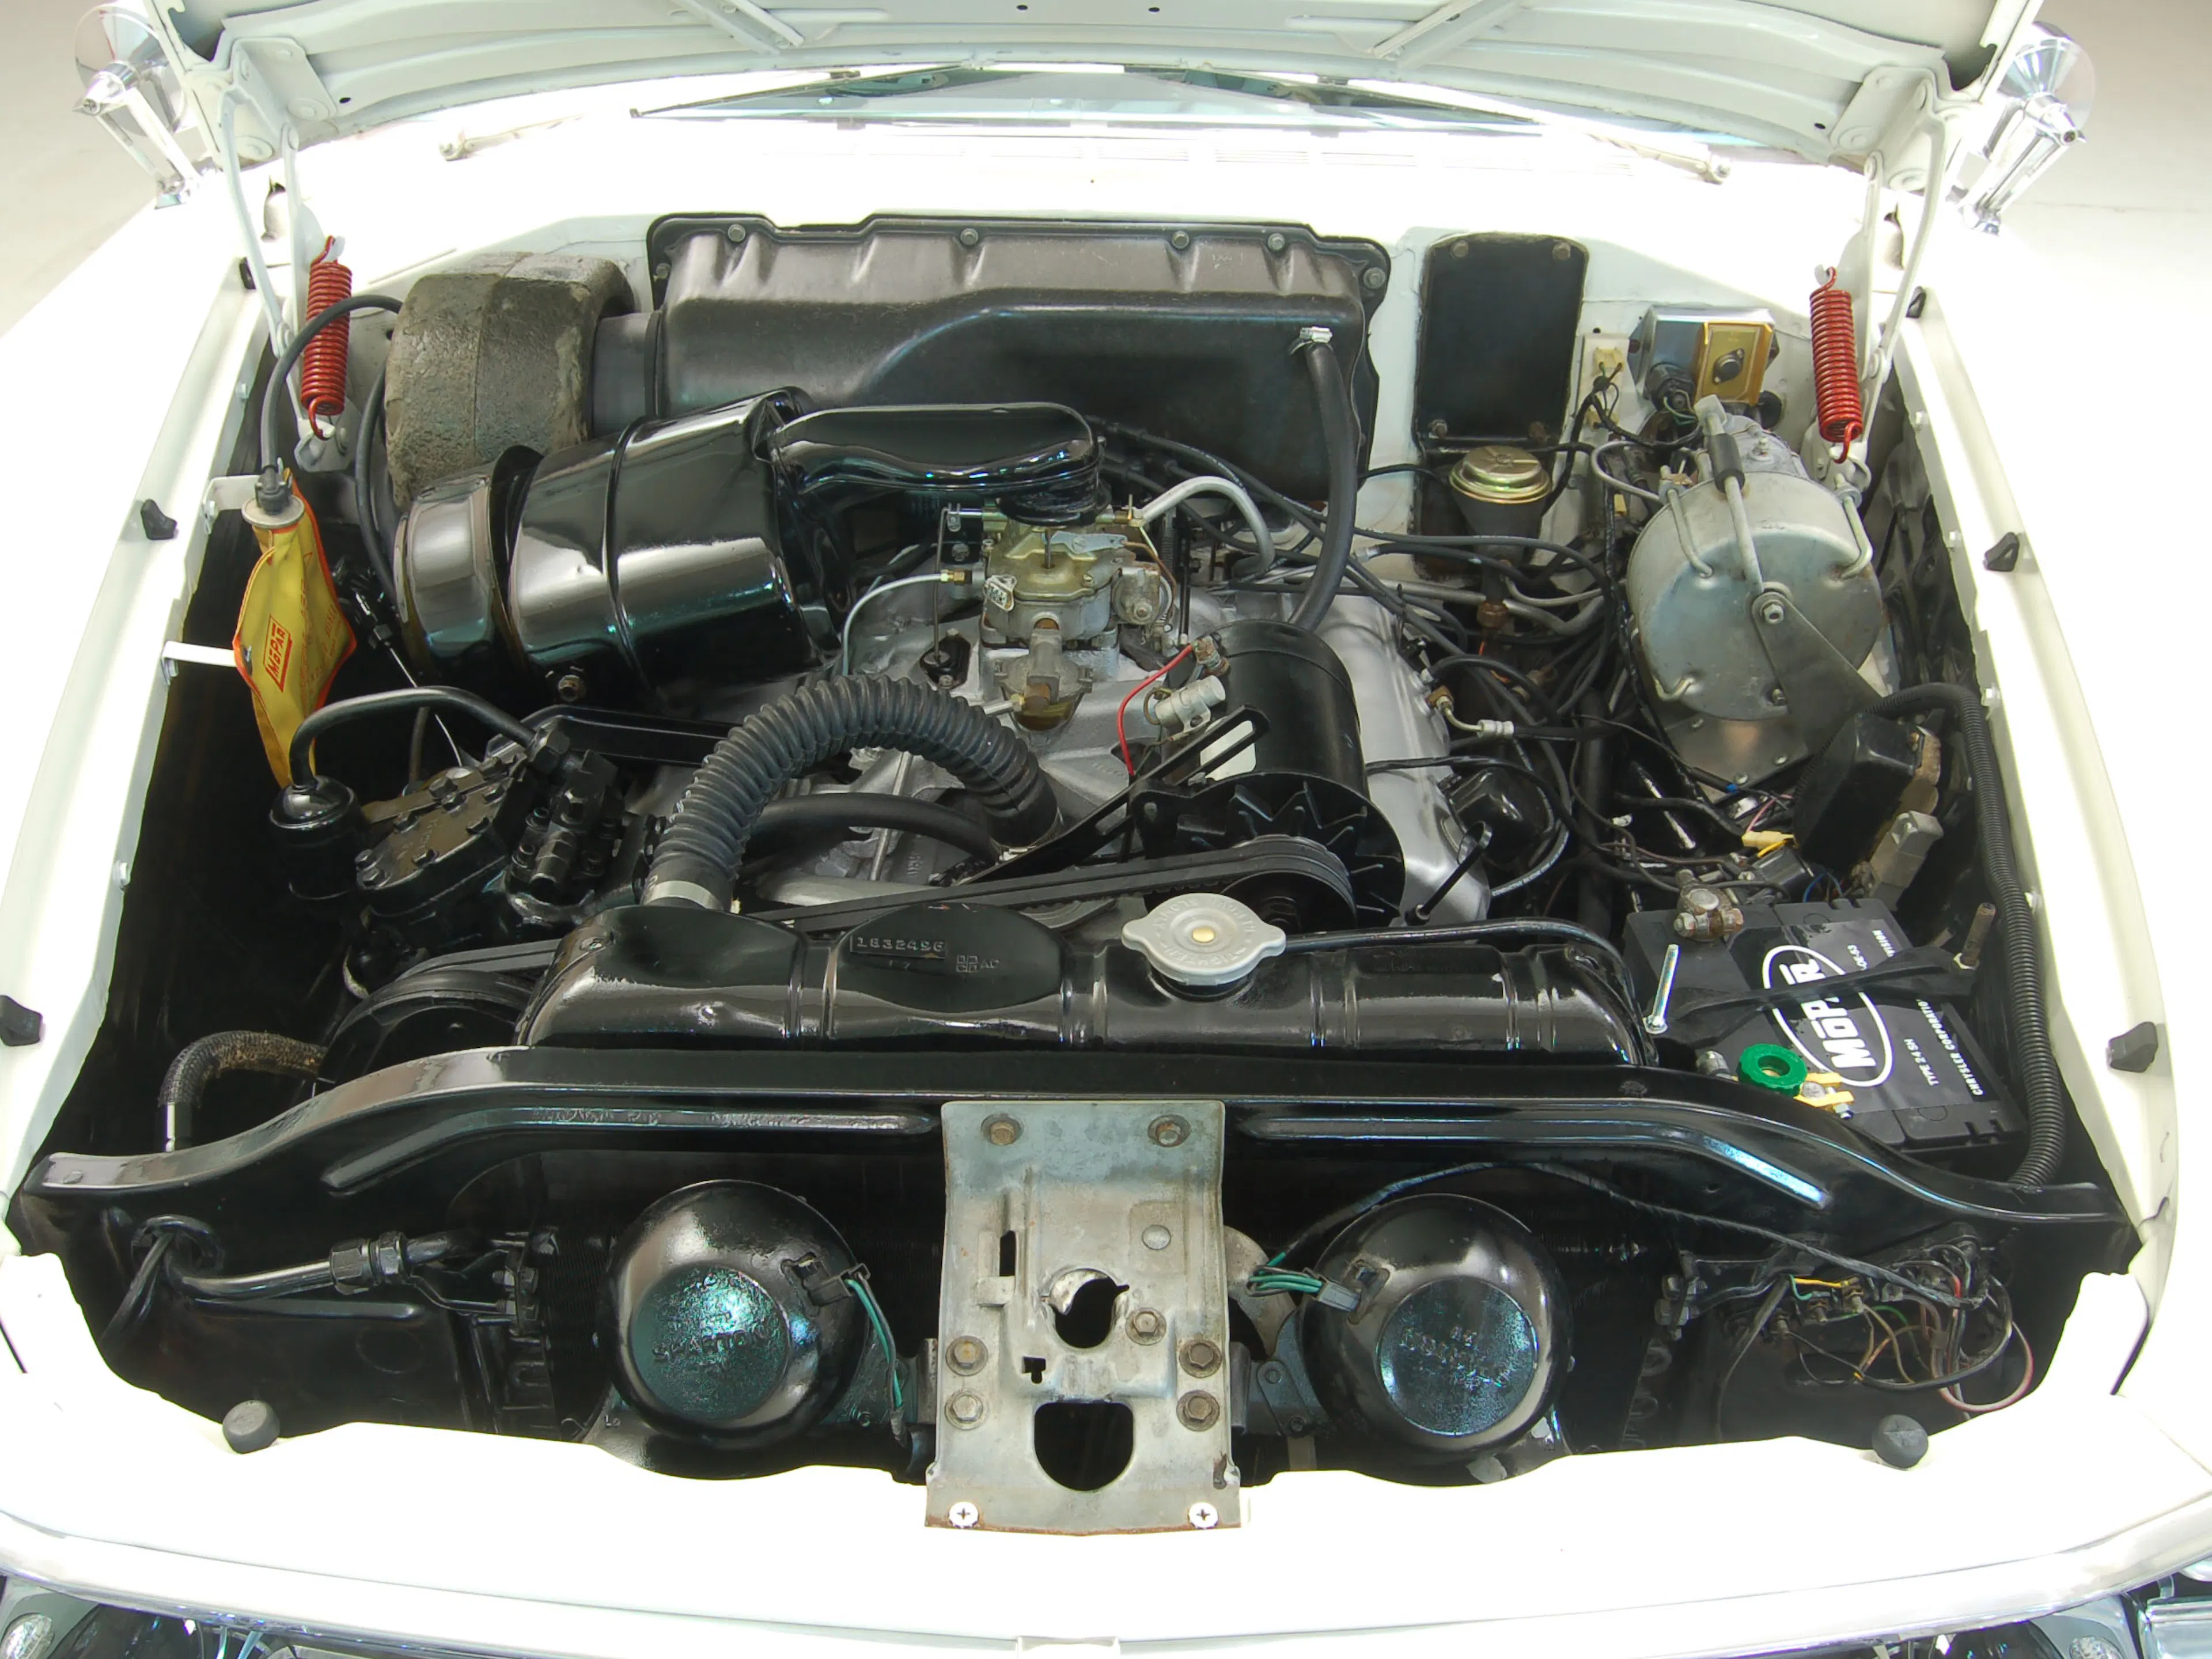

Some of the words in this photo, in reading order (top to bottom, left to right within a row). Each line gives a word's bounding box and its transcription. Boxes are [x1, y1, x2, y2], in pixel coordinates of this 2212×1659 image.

[267, 622, 286, 677] MOPAR
[1779, 959, 1876, 1068] MOPR
[1916, 999, 1955, 1050] CORPORATIO
[1919, 1064, 1940, 1086] TYPE
[1950, 1052, 1983, 1095] CHRYSLER
